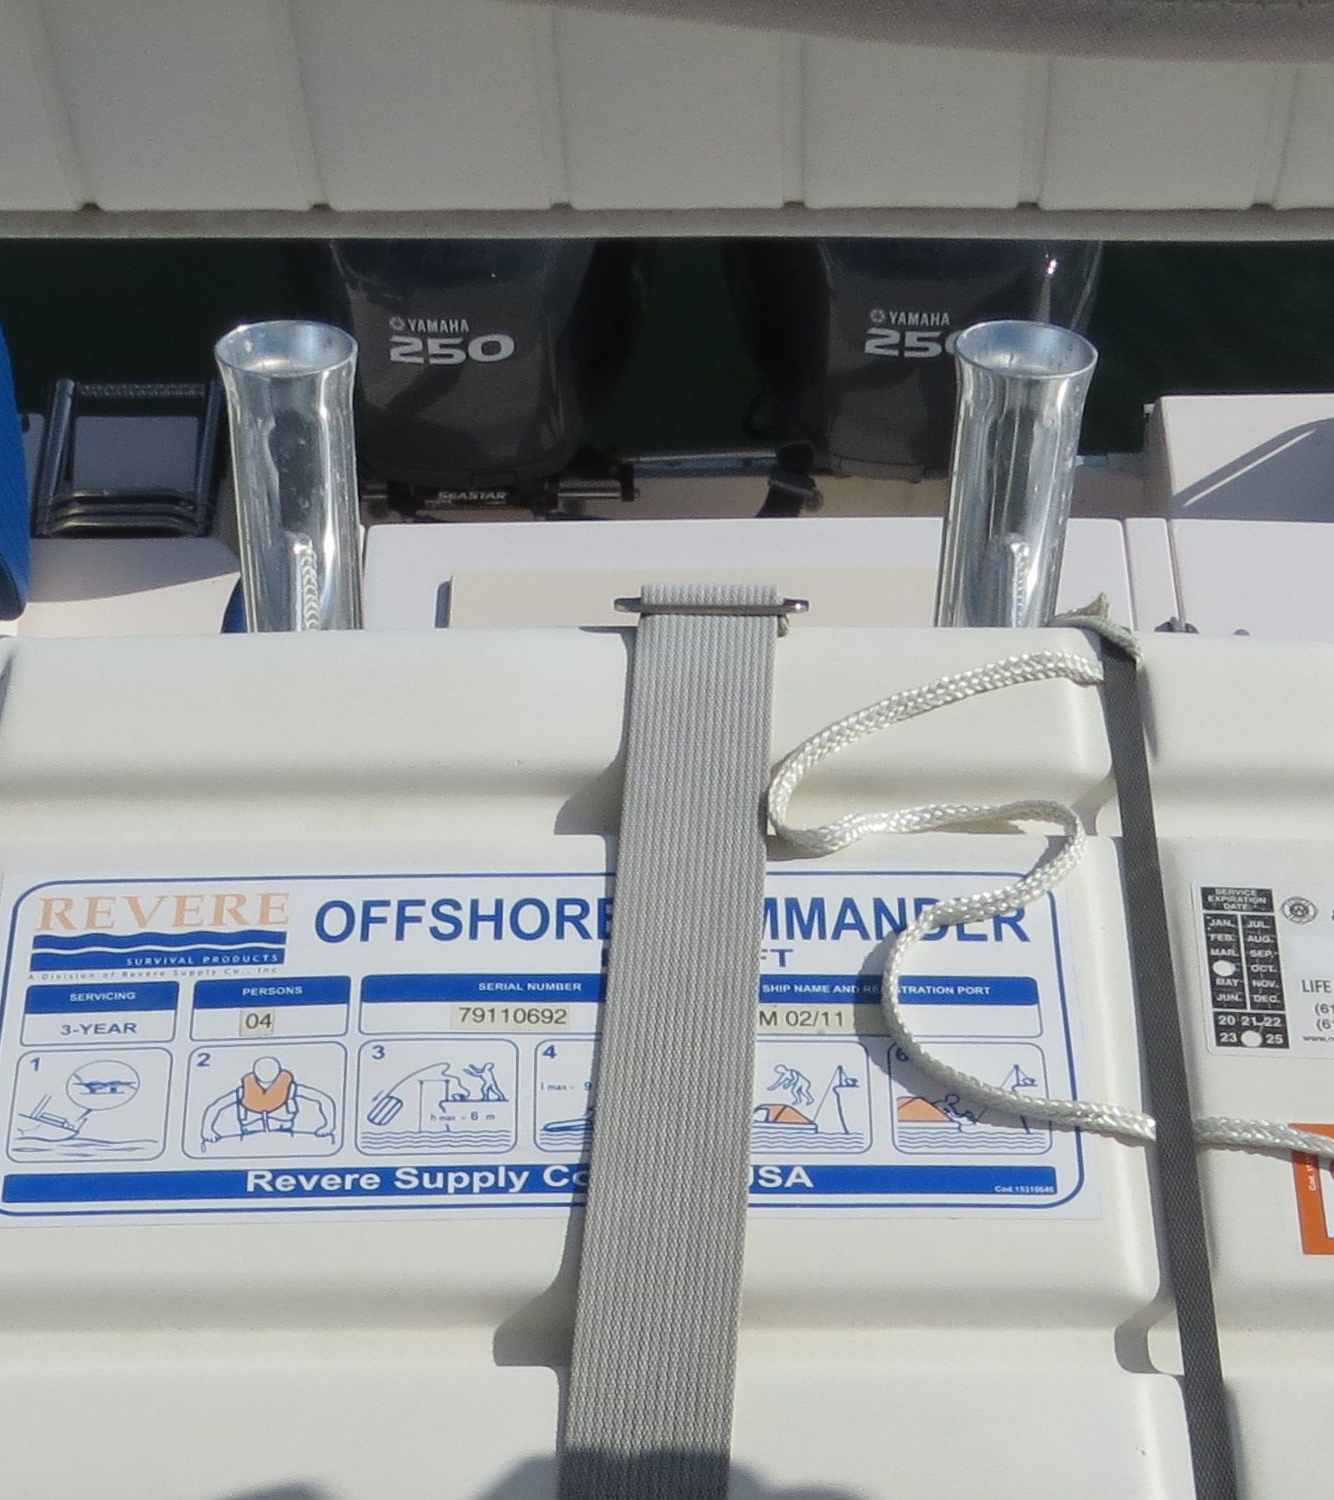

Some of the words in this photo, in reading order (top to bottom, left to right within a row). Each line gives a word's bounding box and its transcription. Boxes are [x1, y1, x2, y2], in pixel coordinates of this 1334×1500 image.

[407, 317, 470, 333] YAMAHA
[889, 310, 951, 327] YAMAHA
[389, 333, 515, 365] 250
[1207, 895, 1267, 904] EXPIRATION
[1215, 889, 1257, 897] SERVICE
[36, 892, 291, 931] REVERE
[314, 897, 614, 944] OFFSHORE
[125, 956, 195, 967] SURVIVAL
[202, 953, 280, 965] PRODUCTS
[122, 970, 166, 978] Revere
[172, 968, 216, 977] Supply
[242, 985, 303, 997] PERSONS
[478, 982, 524, 992] SERIAL
[527, 982, 582, 992] NUMBER
[762, 984, 791, 994] SHIP
[794, 984, 832, 994] NAME
[833, 984, 861, 994] AND
[957, 986, 992, 996] PORT
[1301, 979, 1332, 995] LIFE
[69, 990, 137, 1002] SERVICING
[244, 1012, 273, 1030] 04
[458, 1006, 568, 1025] 79110692
[785, 1010, 843, 1027] 02/11
[1218, 1015, 1236, 1026] 20
[1241, 1015, 1259, 1027] 21
[1263, 1016, 1282, 1027] 22
[60, 1022, 138, 1037] 3-YEAR
[1219, 1032, 1238, 1043] 23
[1265, 1033, 1283, 1044] 25
[371, 1045, 386, 1060] 3
[542, 1044, 557, 1060] 4
[895, 1047, 909, 1062] 6
[30, 1057, 41, 1072] 1
[196, 1052, 211, 1068] 2
[246, 1169, 381, 1194] Revere
[394, 1167, 529, 1198] Supply
